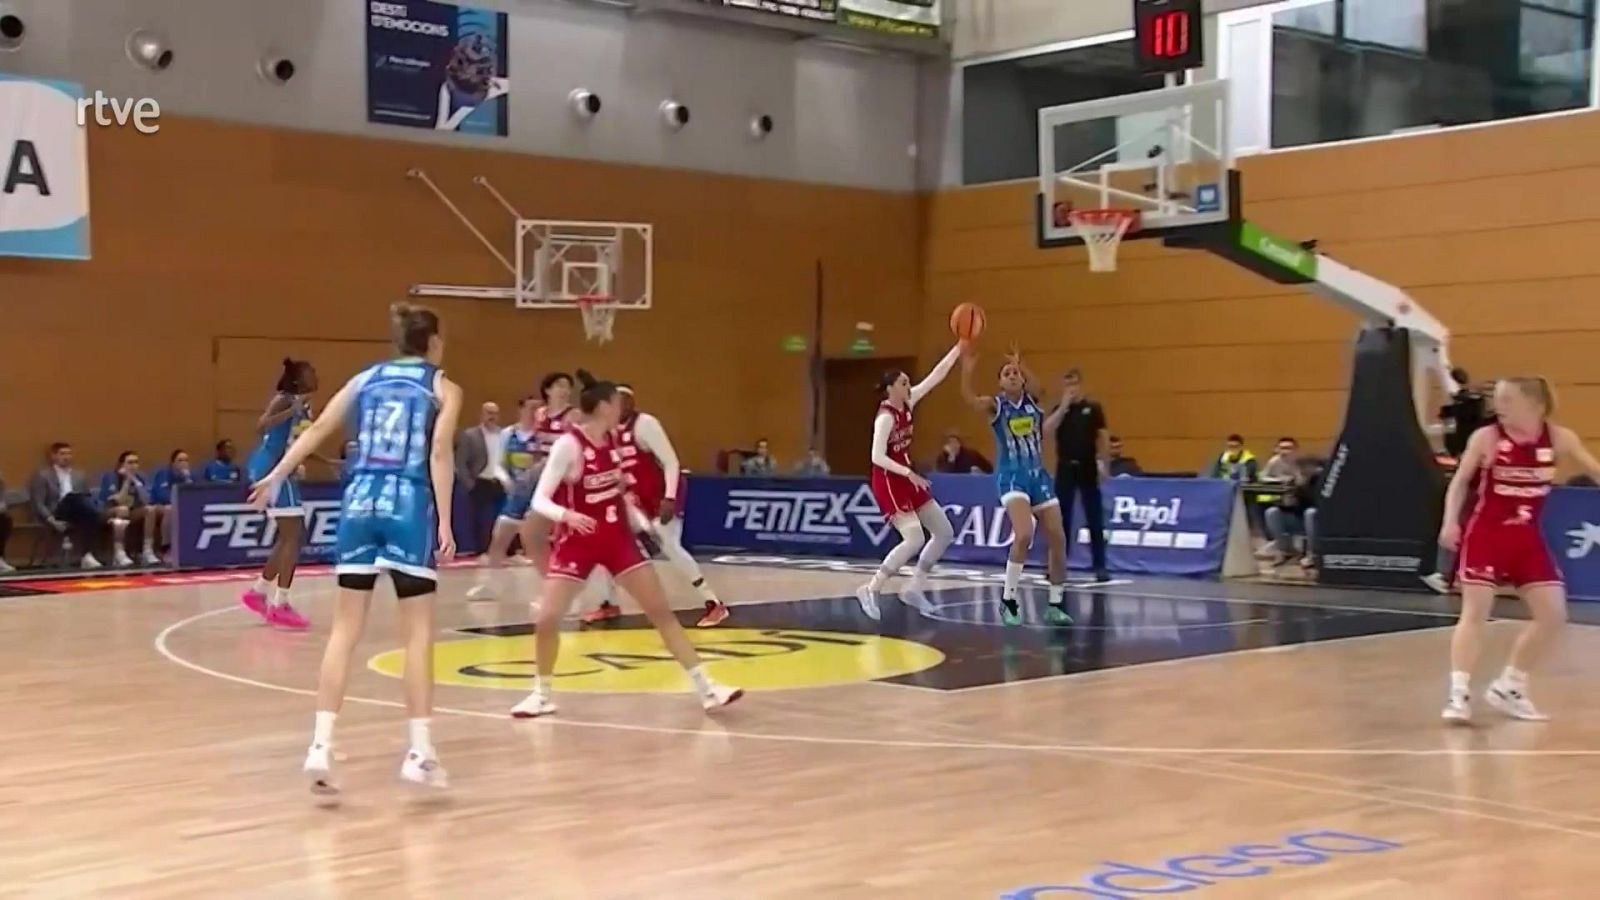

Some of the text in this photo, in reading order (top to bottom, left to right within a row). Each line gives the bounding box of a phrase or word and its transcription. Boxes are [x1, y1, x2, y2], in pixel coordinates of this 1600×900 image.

[1154, 11, 1188, 56] 10
[3, 139, 51, 196] A
[382, 401, 405, 439] 7
[724, 490, 850, 532] PENTEX
[1109, 496, 1182, 530] Pujol
